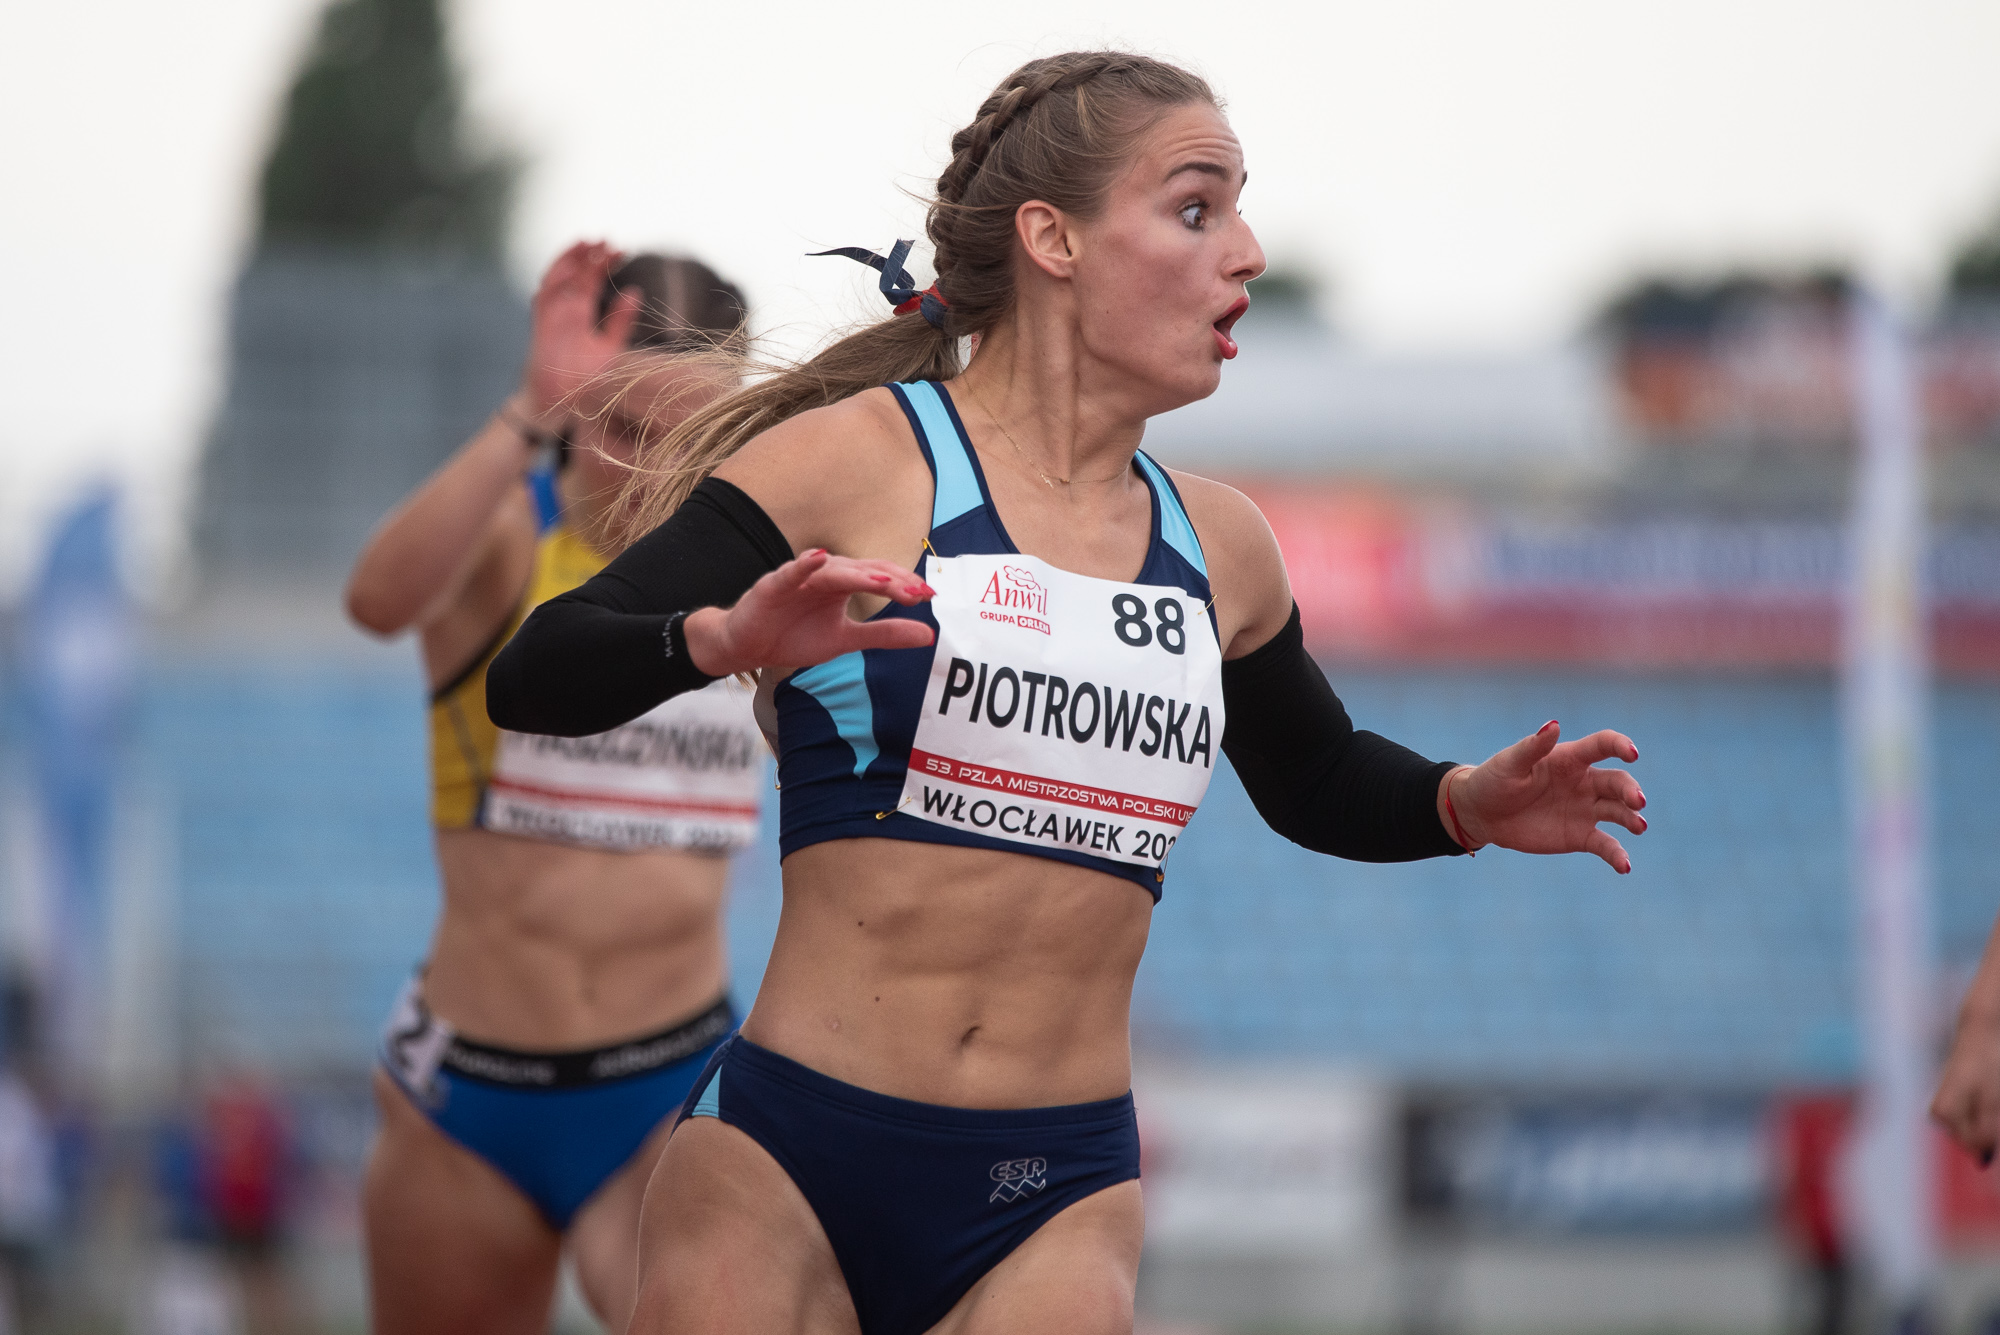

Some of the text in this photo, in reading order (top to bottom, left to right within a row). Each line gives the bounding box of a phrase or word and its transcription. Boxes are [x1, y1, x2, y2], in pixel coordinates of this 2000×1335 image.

[979, 570, 1048, 616] Anwil
[980, 611, 1050, 635] GRUPA ORLEN
[1112, 593, 1186, 655] 88
[938, 657, 1211, 768] PIOTROWSKA
[923, 785, 1125, 854] WŁOCŁAWEK
[926, 758, 954, 776] 53.
[958, 767, 1004, 787] PZLA
[1007, 777, 1119, 810] MISTRZOSTWA
[1122, 798, 1176, 820] POLSKI
